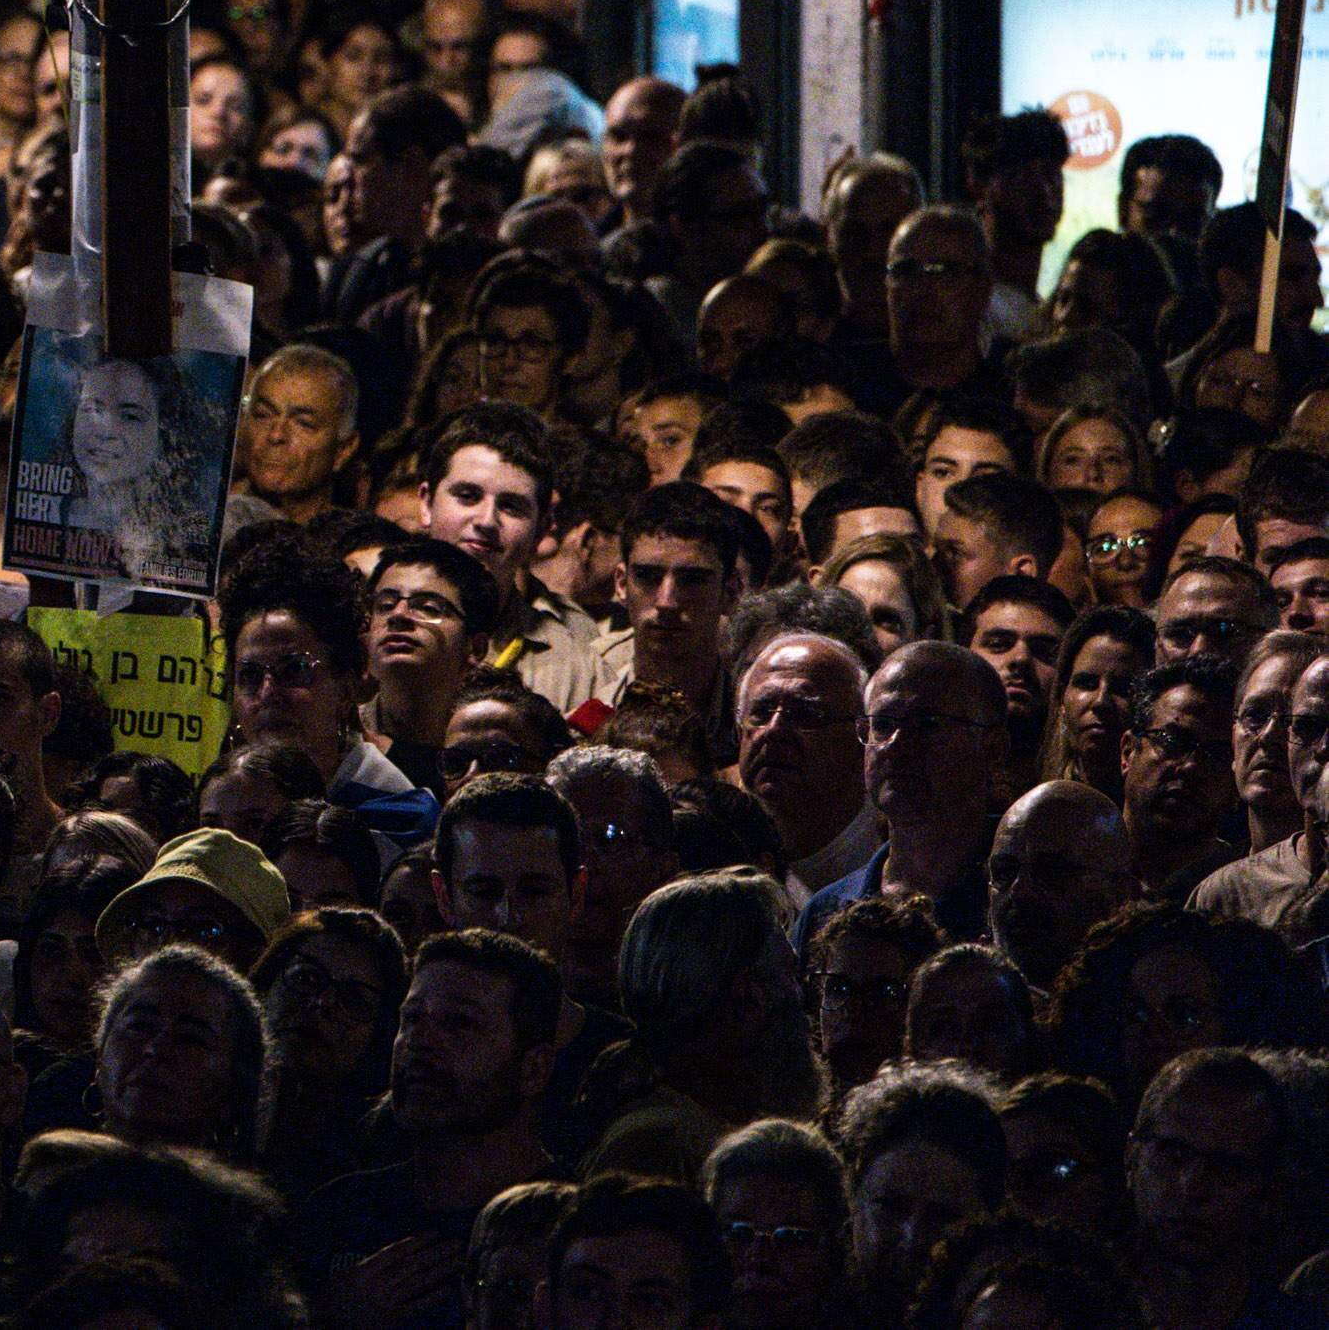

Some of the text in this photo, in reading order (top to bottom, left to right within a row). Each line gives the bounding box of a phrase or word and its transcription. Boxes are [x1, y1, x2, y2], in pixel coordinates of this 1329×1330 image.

[17, 460, 74, 495] BRING
[15, 491, 50, 523] HER
[11, 522, 64, 559] HOME
[111, 650, 139, 684] בן
[157, 654, 227, 701] ברהם
[113, 707, 203, 743] פרשטי
